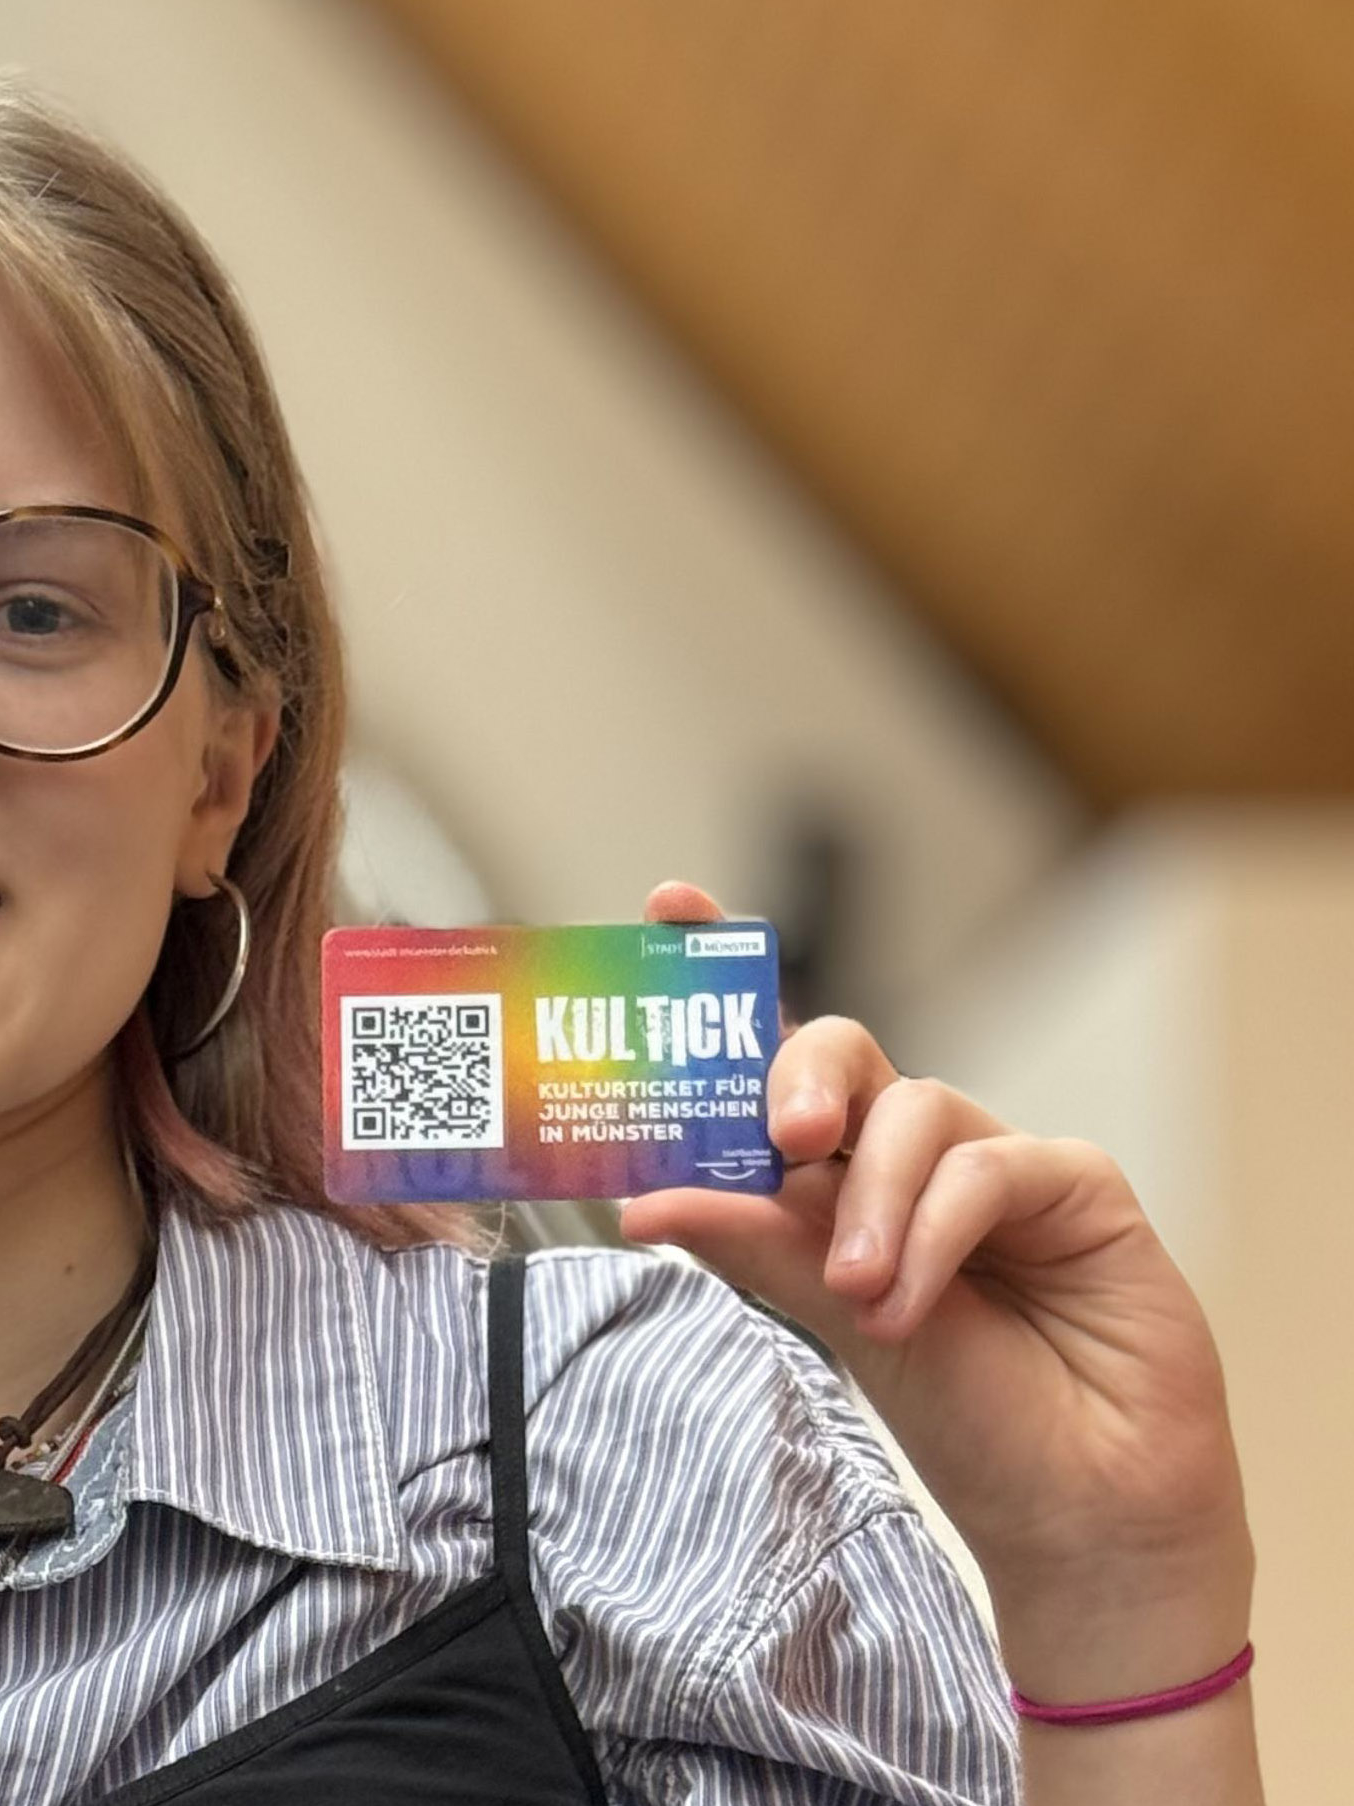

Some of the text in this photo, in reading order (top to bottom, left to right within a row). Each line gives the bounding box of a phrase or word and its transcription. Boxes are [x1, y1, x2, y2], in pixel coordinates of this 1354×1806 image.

[538, 1074, 762, 1100] KULTURTICKET FÜR
[538, 1100, 758, 1121] JUNGE MENSCHEN
[539, 1118, 683, 1143] IN MÜNSTER
